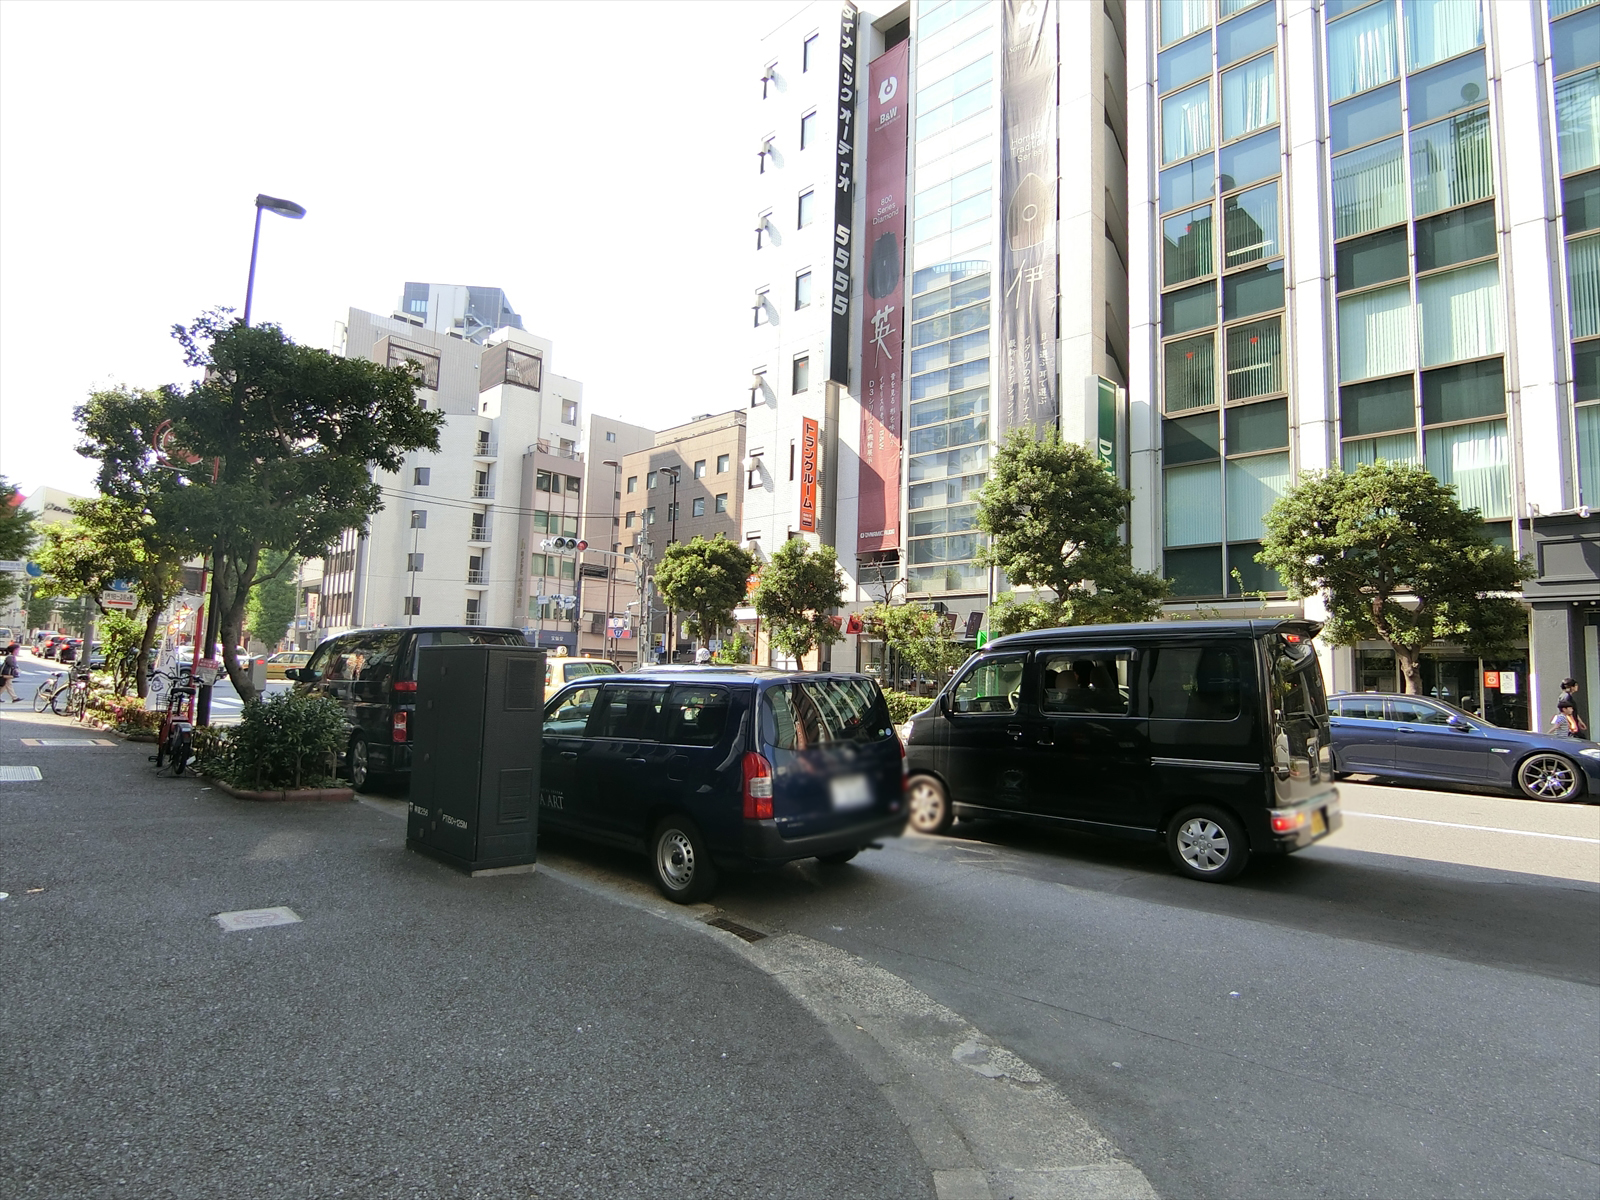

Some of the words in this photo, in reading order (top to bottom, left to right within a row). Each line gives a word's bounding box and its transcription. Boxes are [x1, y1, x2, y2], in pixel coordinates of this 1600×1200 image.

[838, 4, 856, 192] ダイナミックオーディオ
[880, 106, 898, 125] B&W
[1011, 130, 1045, 147] Homag
[1017, 147, 1043, 163] Seres
[877, 202, 896, 216] Series
[880, 194, 893, 206] 800
[872, 207, 899, 225] Diamond
[833, 223, 851, 316] 5555
[869, 304, 896, 369] 英
[1022, 335, 1031, 395] イタリアの名門
[803, 423, 815, 509] トランクルーム
[547, 794, 564, 810] ART
